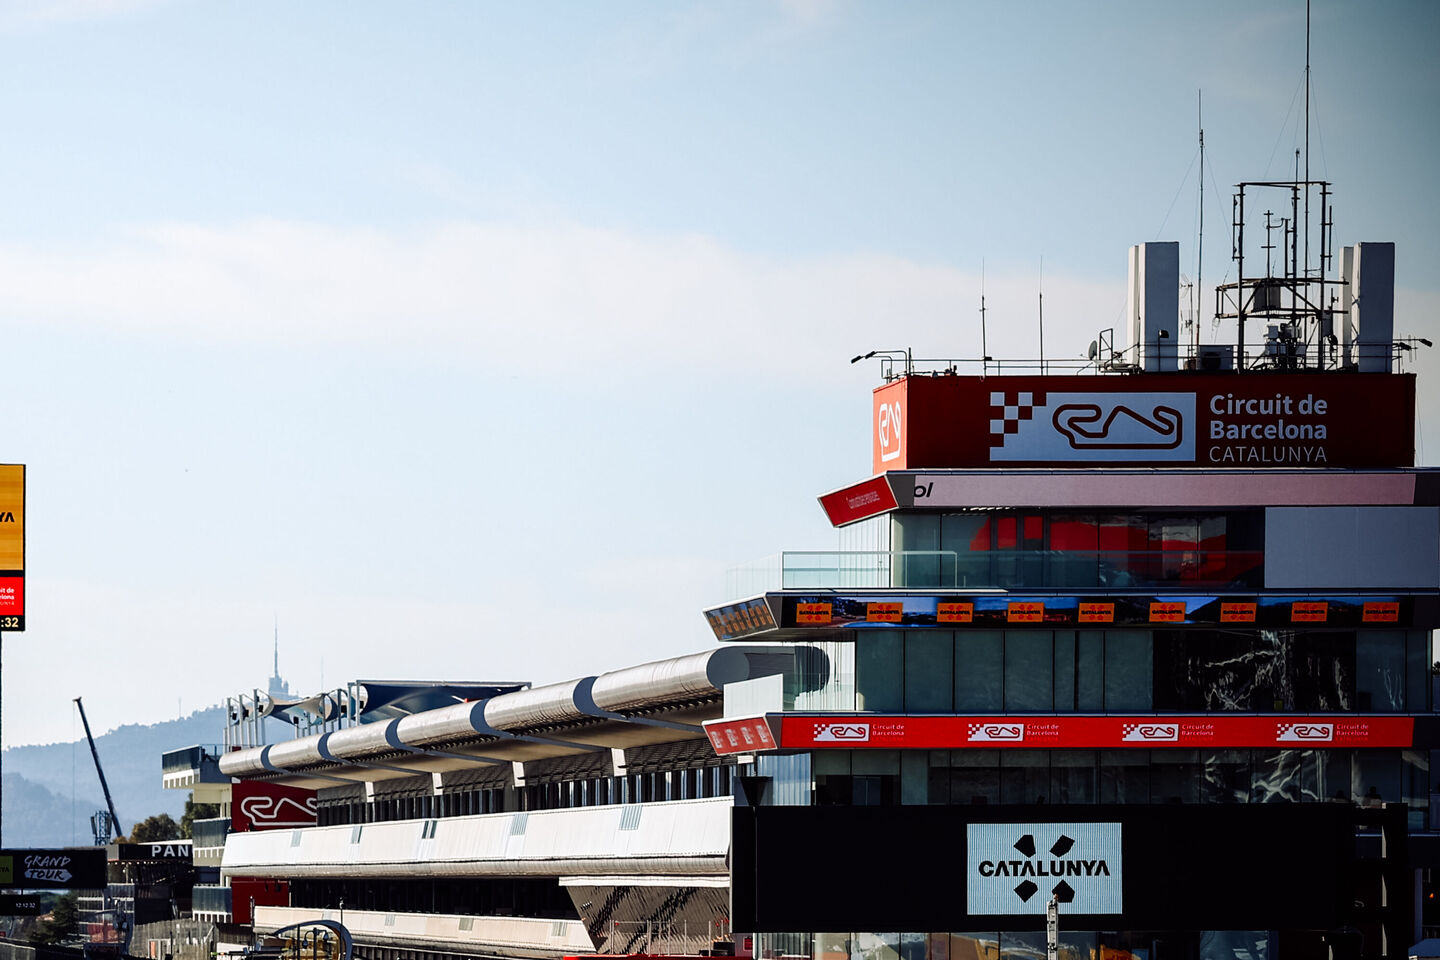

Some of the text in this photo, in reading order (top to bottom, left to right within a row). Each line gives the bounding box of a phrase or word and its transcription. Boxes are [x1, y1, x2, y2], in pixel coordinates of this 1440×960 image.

[1210, 393, 1328, 415] Circuit de
[1210, 419, 1327, 439] Barcelona
[1209, 446, 1327, 462] CATALUNYA
[23, 855, 72, 868] GRAND
[978, 860, 1110, 877] CATALUNYA
[29, 869, 64, 880] TOUR
